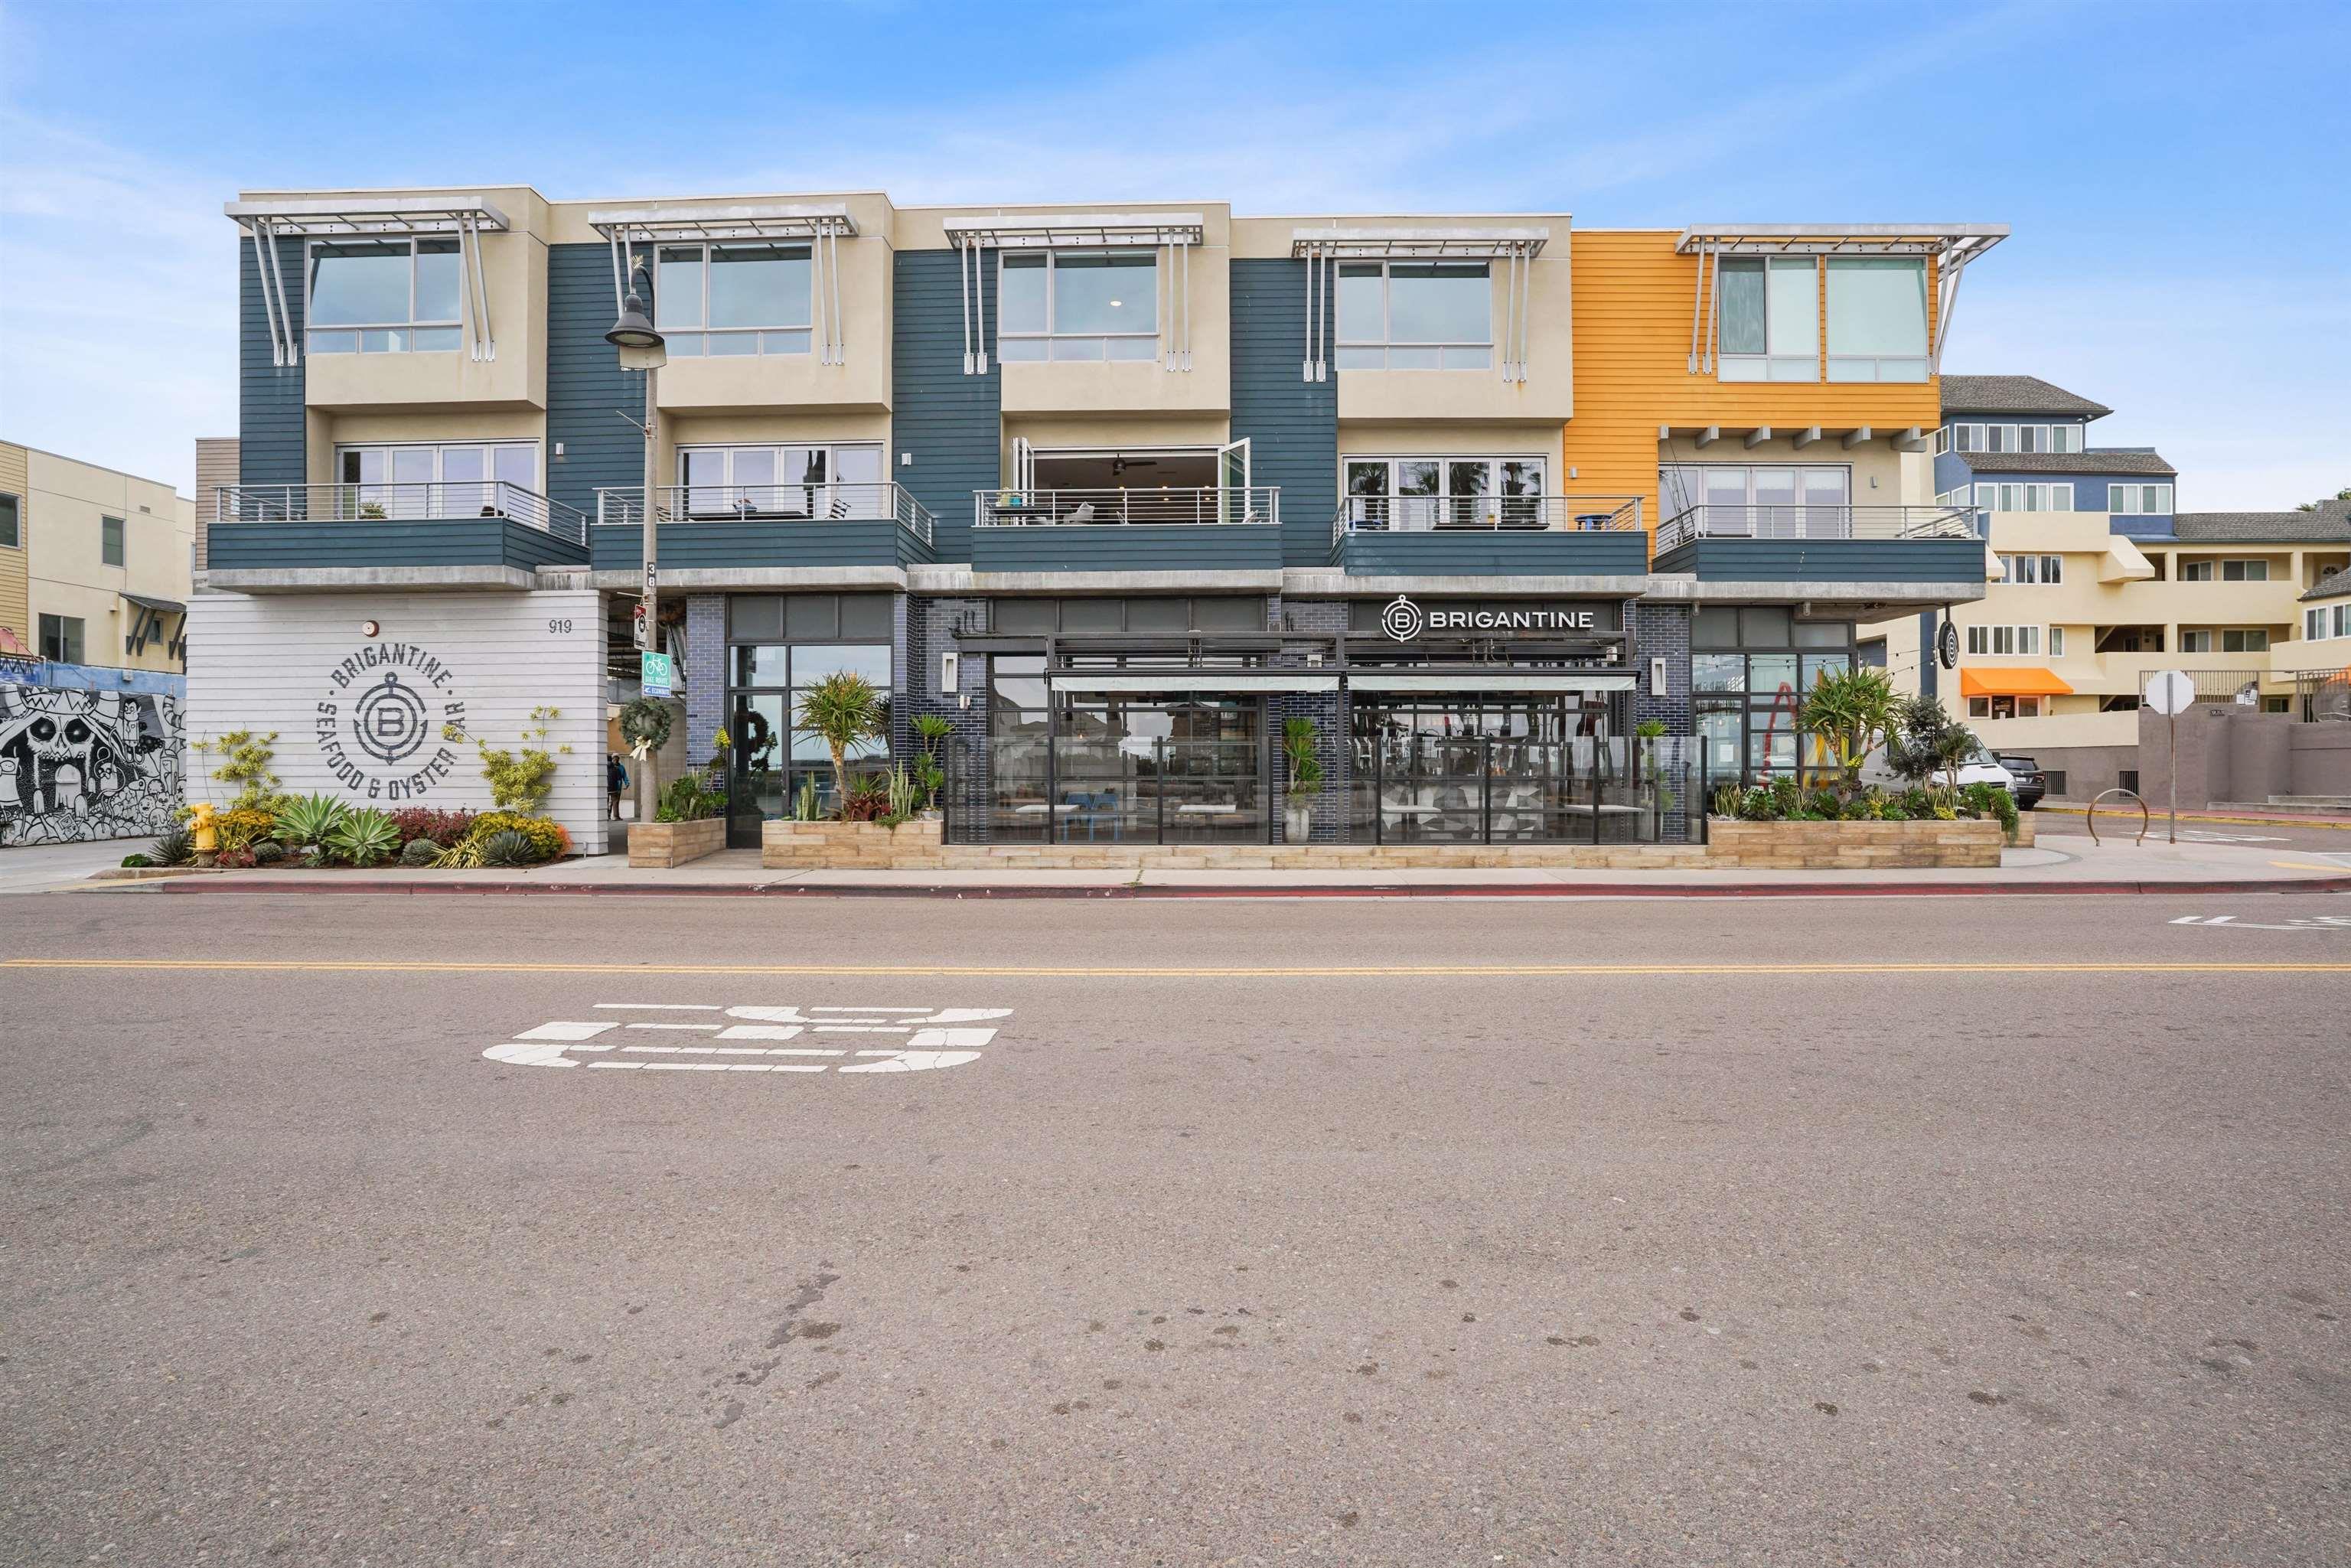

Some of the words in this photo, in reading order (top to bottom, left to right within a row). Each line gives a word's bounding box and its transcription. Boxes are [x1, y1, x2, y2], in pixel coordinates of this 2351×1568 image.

[549, 619, 572, 634] 919
[1394, 613, 1410, 628] B
[1430, 611, 1594, 628] BRIGANTINE
[330, 643, 452, 689] BRIGANTINE
[377, 707, 405, 736] B
[316, 702, 364, 791] SEAFOOD
[367, 777, 380, 799] &
[389, 747, 458, 800] OYSTER
